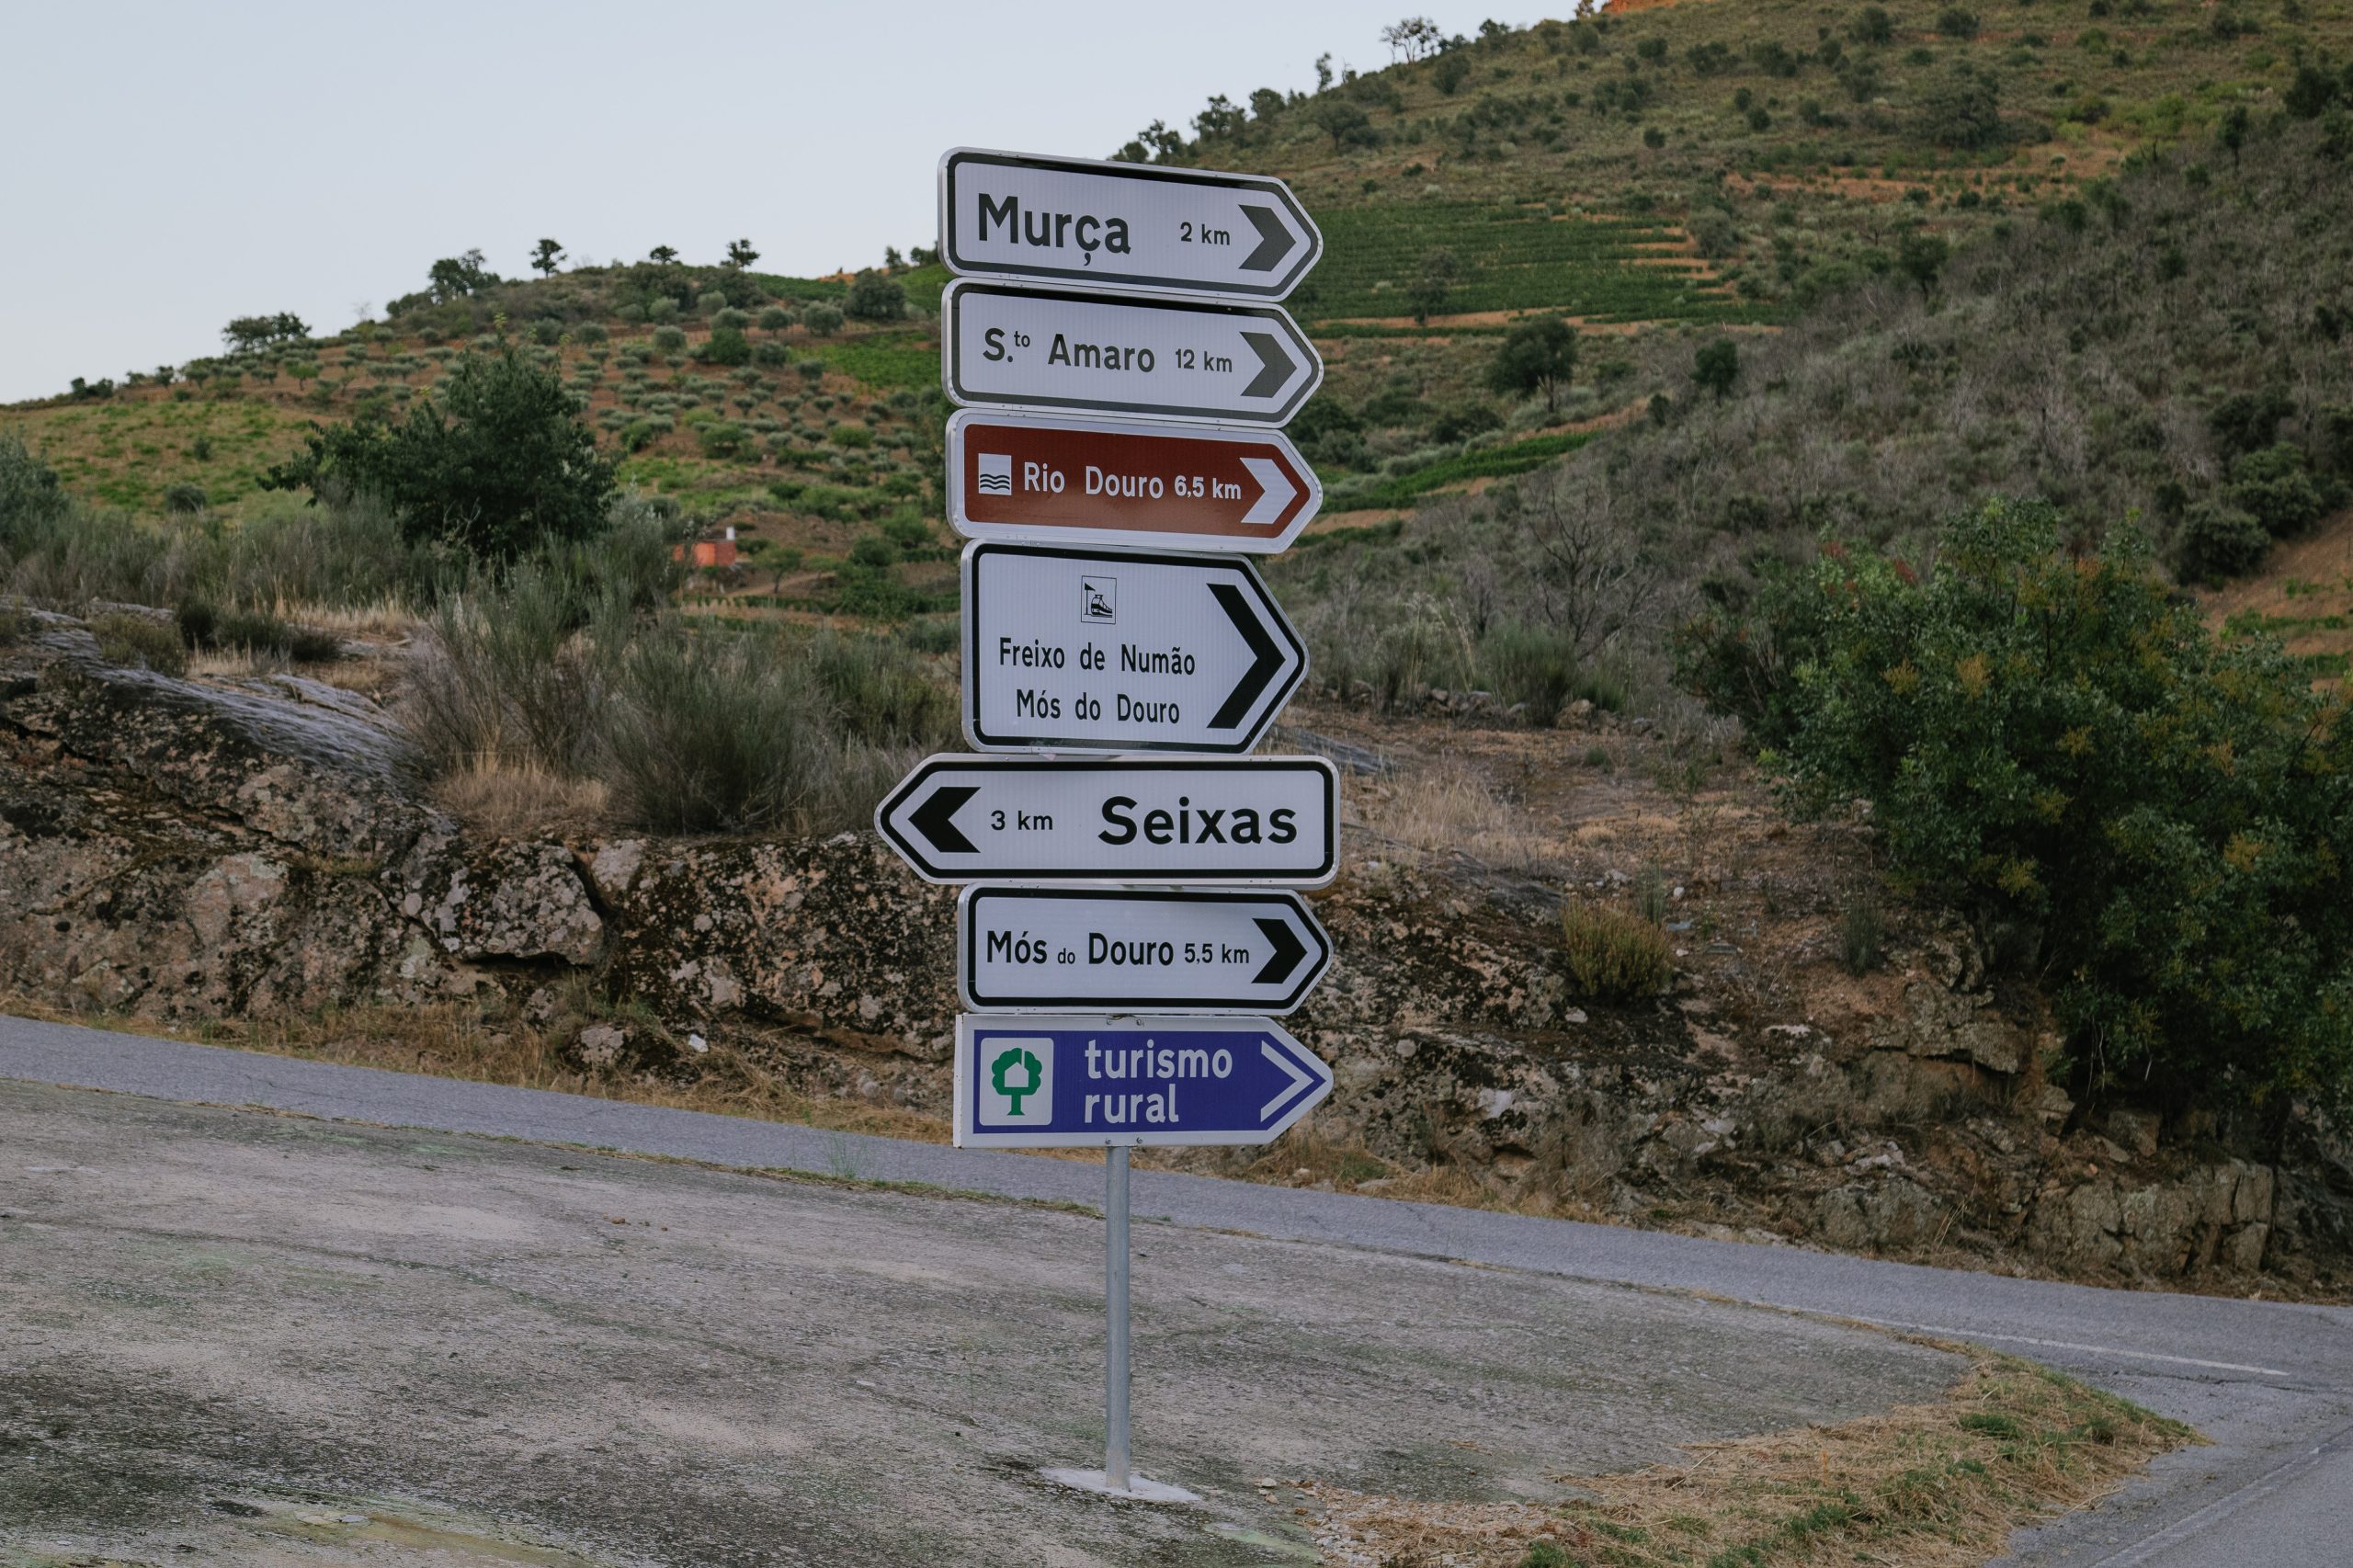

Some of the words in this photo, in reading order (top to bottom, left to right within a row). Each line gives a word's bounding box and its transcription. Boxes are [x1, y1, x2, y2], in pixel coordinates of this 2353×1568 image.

[978, 192, 1131, 267] Murça
[1180, 222, 1192, 243] 2
[1201, 223, 1231, 246] km
[1048, 333, 1155, 373] Amaro
[1175, 348, 1195, 369] 12
[1204, 351, 1233, 373] km
[1024, 461, 1065, 494] Rio
[1086, 465, 1164, 499] Douro
[1174, 474, 1205, 498] 6,5
[1212, 477, 1242, 500] km
[1000, 637, 1065, 669] Freixo
[1080, 642, 1105, 671] de
[1121, 643, 1196, 676] Numão
[1017, 688, 1061, 719] Mós
[1074, 692, 1101, 721] do
[1117, 693, 1180, 724] Douro
[991, 810, 1006, 831] 3
[1017, 810, 1053, 831] km
[1097, 795, 1298, 846] Seixas
[986, 929, 1047, 964] Mós
[1057, 948, 1076, 964] do
[1088, 932, 1174, 966] Douro
[1184, 942, 1213, 967] 5,5
[1222, 943, 1250, 964] km
[1085, 1039, 1233, 1079] turismo
[1085, 1083, 1179, 1123] rural
